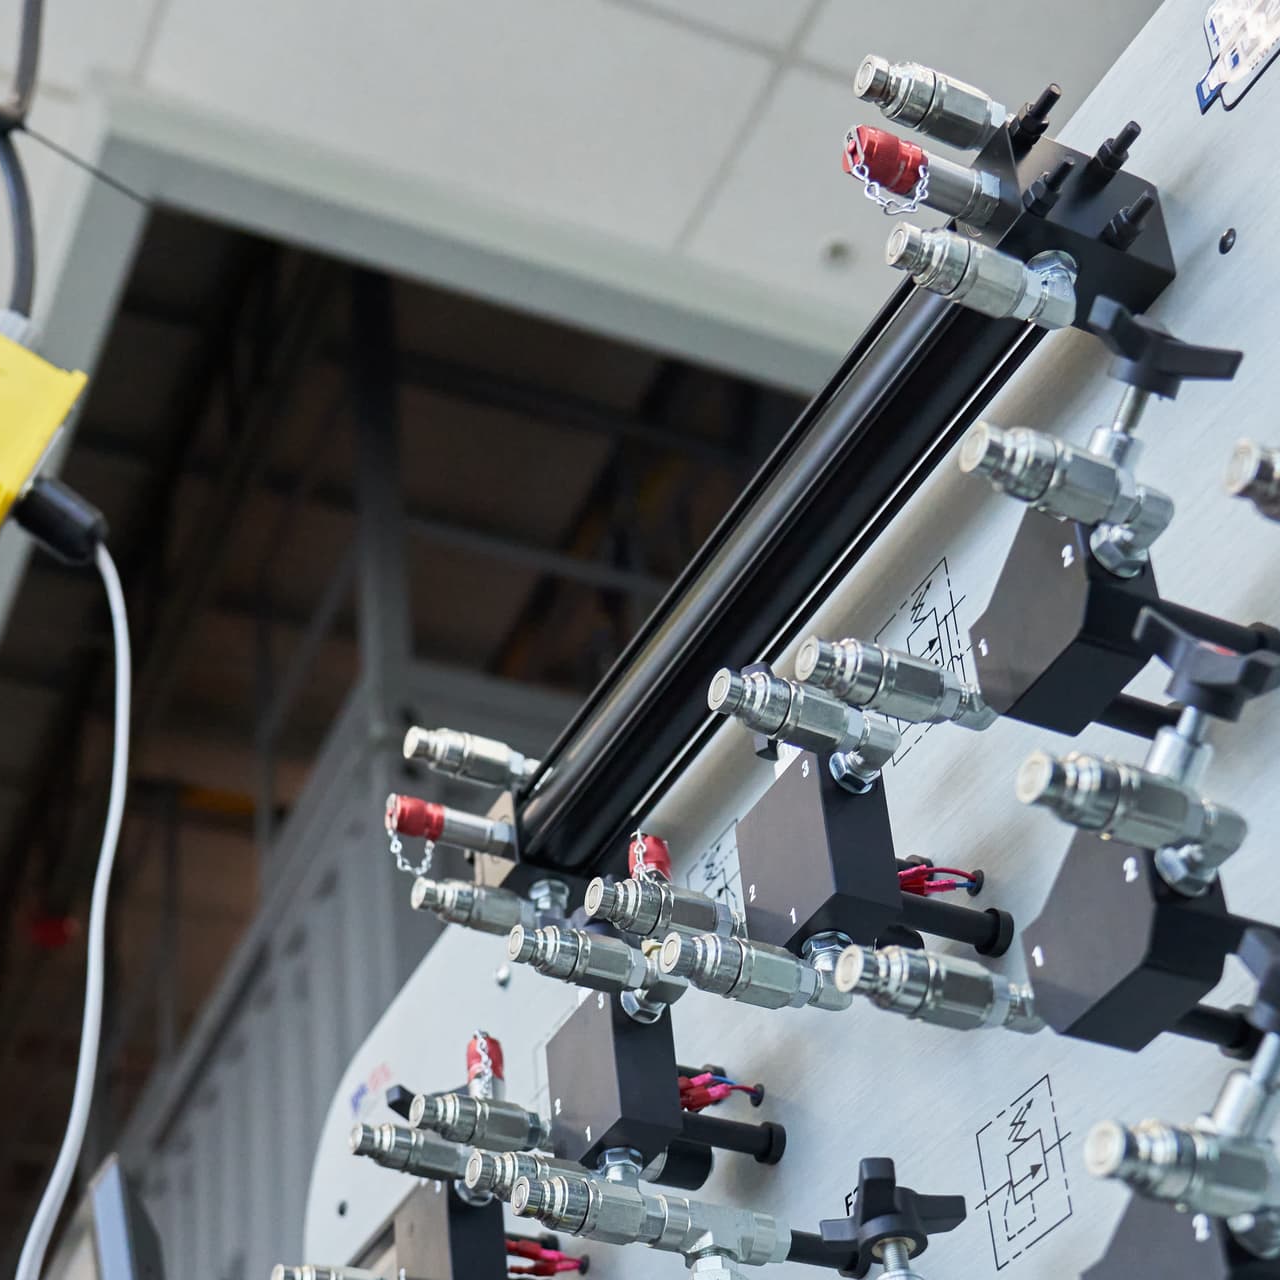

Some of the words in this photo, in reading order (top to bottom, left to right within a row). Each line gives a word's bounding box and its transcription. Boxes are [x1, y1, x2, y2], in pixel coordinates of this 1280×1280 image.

[801, 759, 810, 778] 3
[748, 884, 757, 903] 2
[789, 907, 797, 925] 1
[1031, 945, 1044, 968] 1
